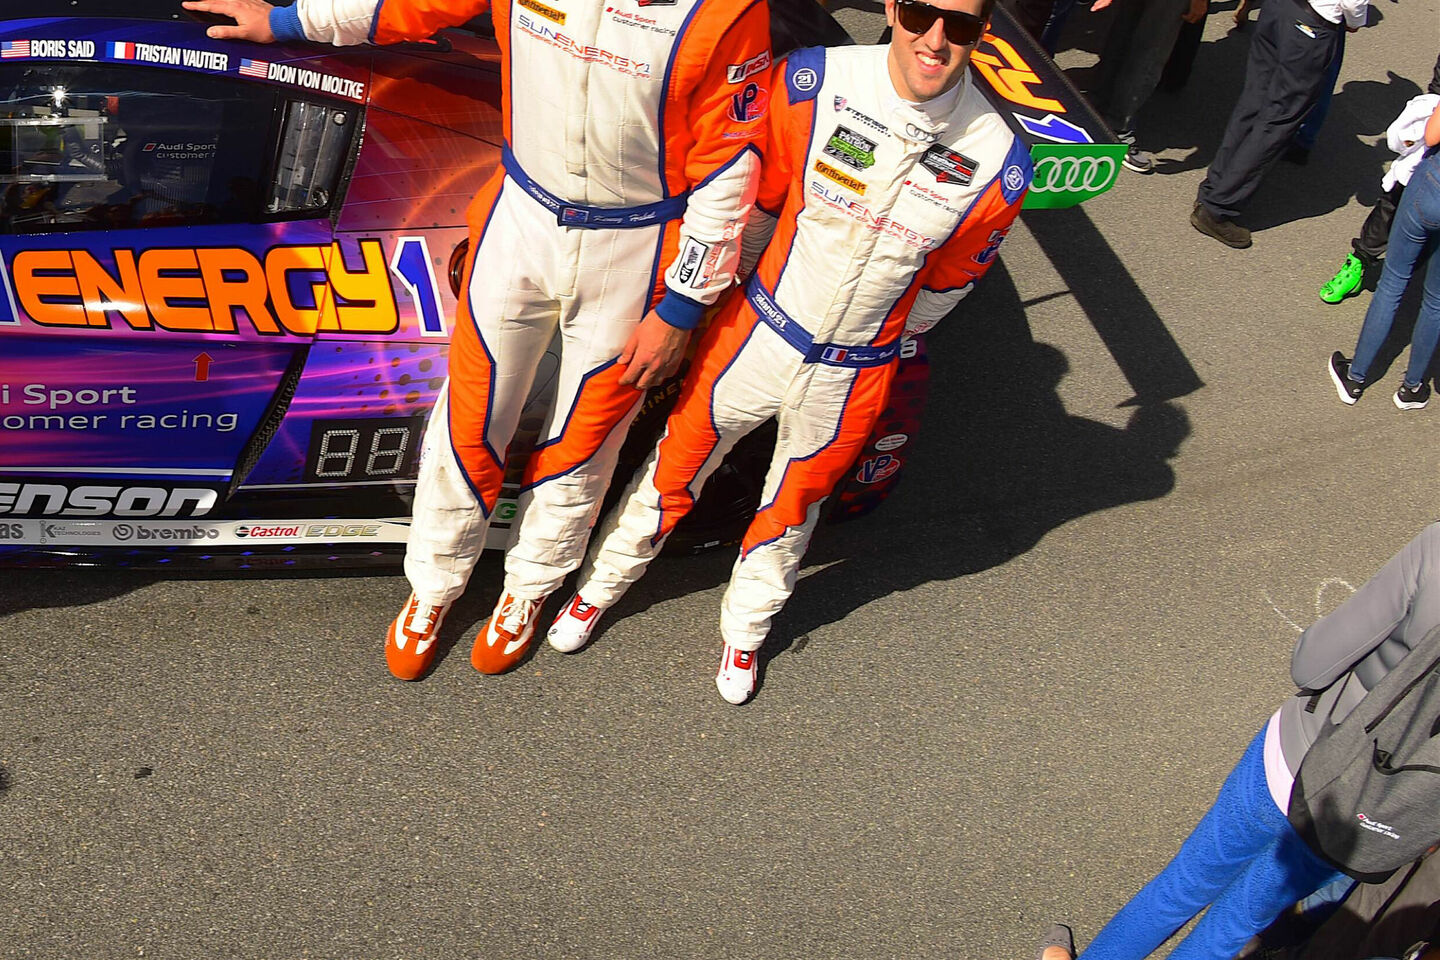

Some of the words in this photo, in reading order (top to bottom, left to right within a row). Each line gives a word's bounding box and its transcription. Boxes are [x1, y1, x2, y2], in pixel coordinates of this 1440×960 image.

[30, 40, 66, 58] BORIS
[67, 40, 95, 58] SAID
[135, 43, 181, 66] TRISTAN
[181, 48, 228, 71] VAUTIER
[518, 14, 651, 75] SUNENERGY1
[267, 62, 296, 84] DION
[296, 69, 321, 90] VON
[320, 74, 364, 100] MOLTKE
[844, 106, 889, 132] STEVENSON
[157, 142, 184, 151] Audi
[816, 161, 866, 192] Continental
[23, 383, 137, 411] Sport
[119, 409, 239, 433] racing
[315, 427, 411, 478] 88
[136, 524, 220, 539] brembo
[250, 524, 300, 538] Castrol
[305, 524, 382, 538] EDGE
